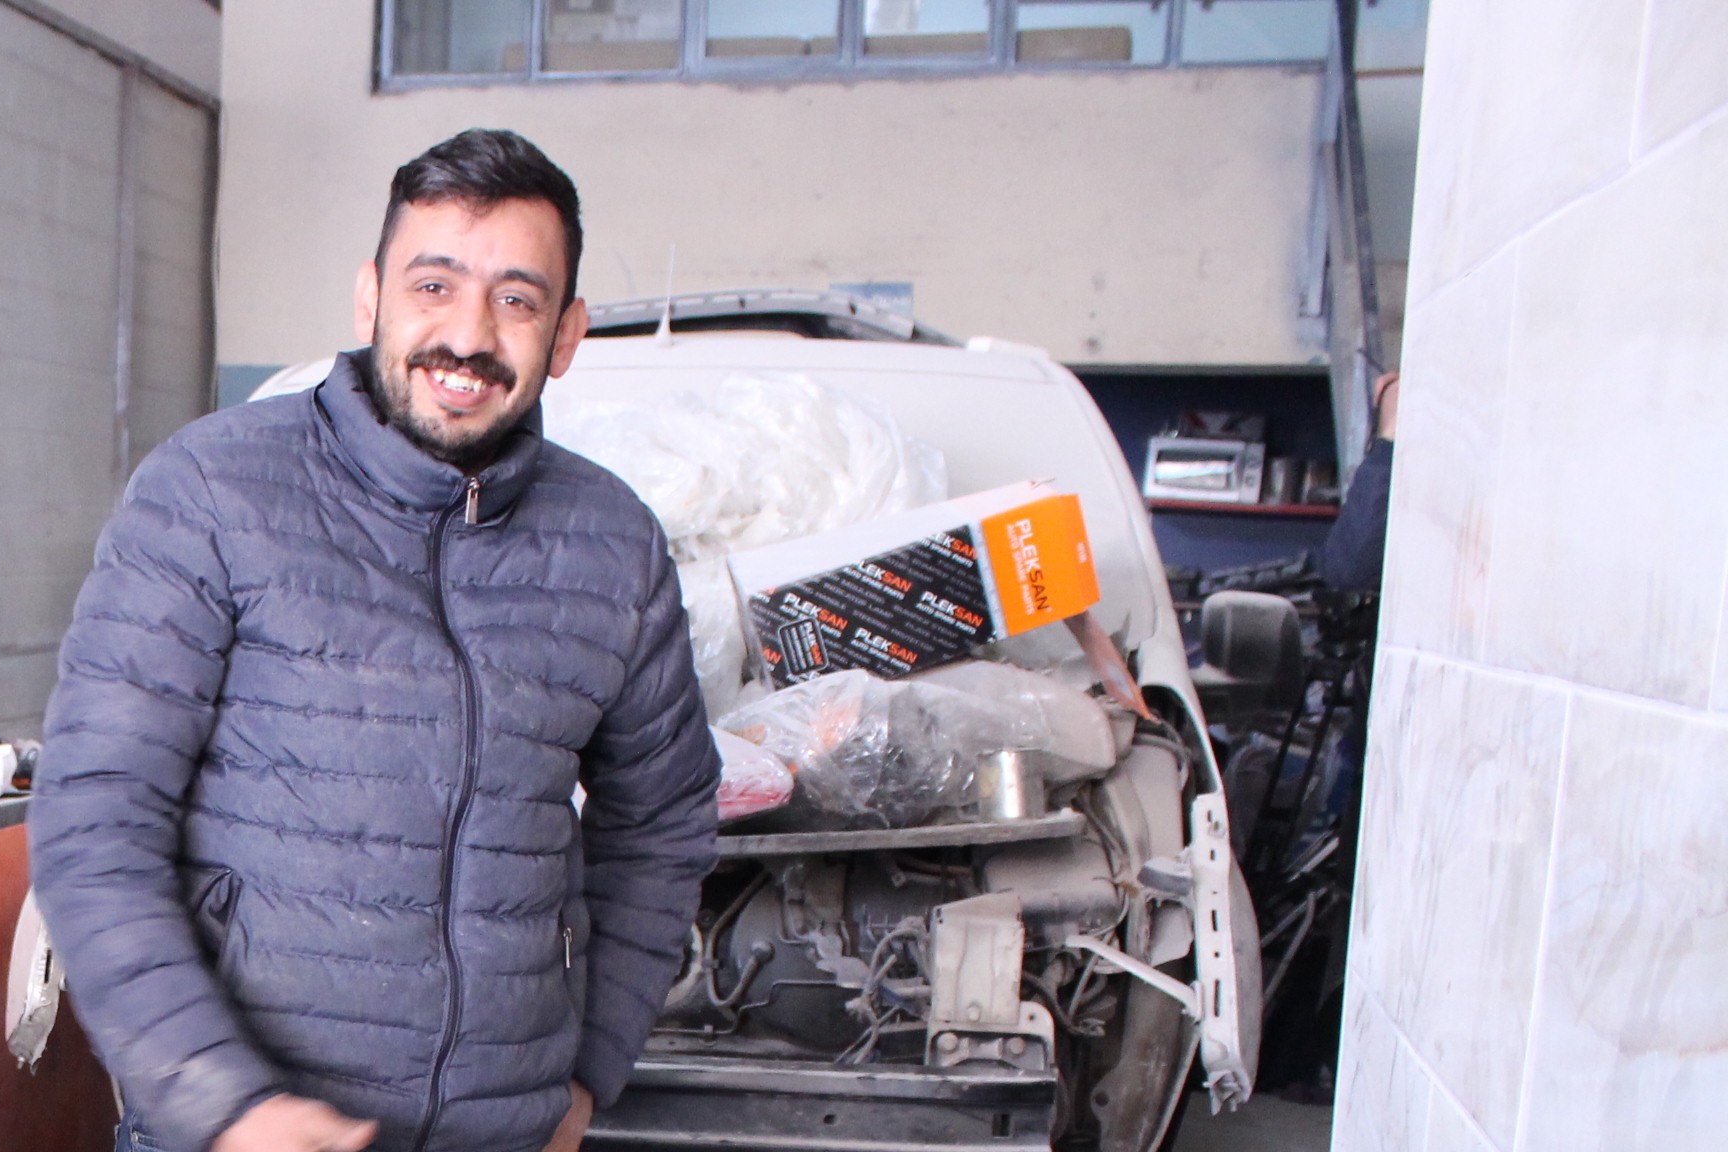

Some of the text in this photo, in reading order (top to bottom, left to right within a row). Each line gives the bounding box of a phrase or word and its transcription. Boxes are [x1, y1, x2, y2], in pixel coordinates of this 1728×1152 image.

[855, 560, 912, 594] LEKSAN
[1015, 519, 1049, 610] PLEKSAN
[860, 574, 883, 591] SPARE
[883, 585, 905, 601] PARTS
[783, 592, 849, 630] PLEKSAN
[915, 602, 977, 635] AUTO SPARE PARTS
[920, 590, 984, 628] PLEKSAN
[850, 638, 870, 652] AUTO
[868, 647, 890, 662] SPARE
[889, 657, 912, 672] PARTS
[854, 627, 919, 664] PLEKSAN
